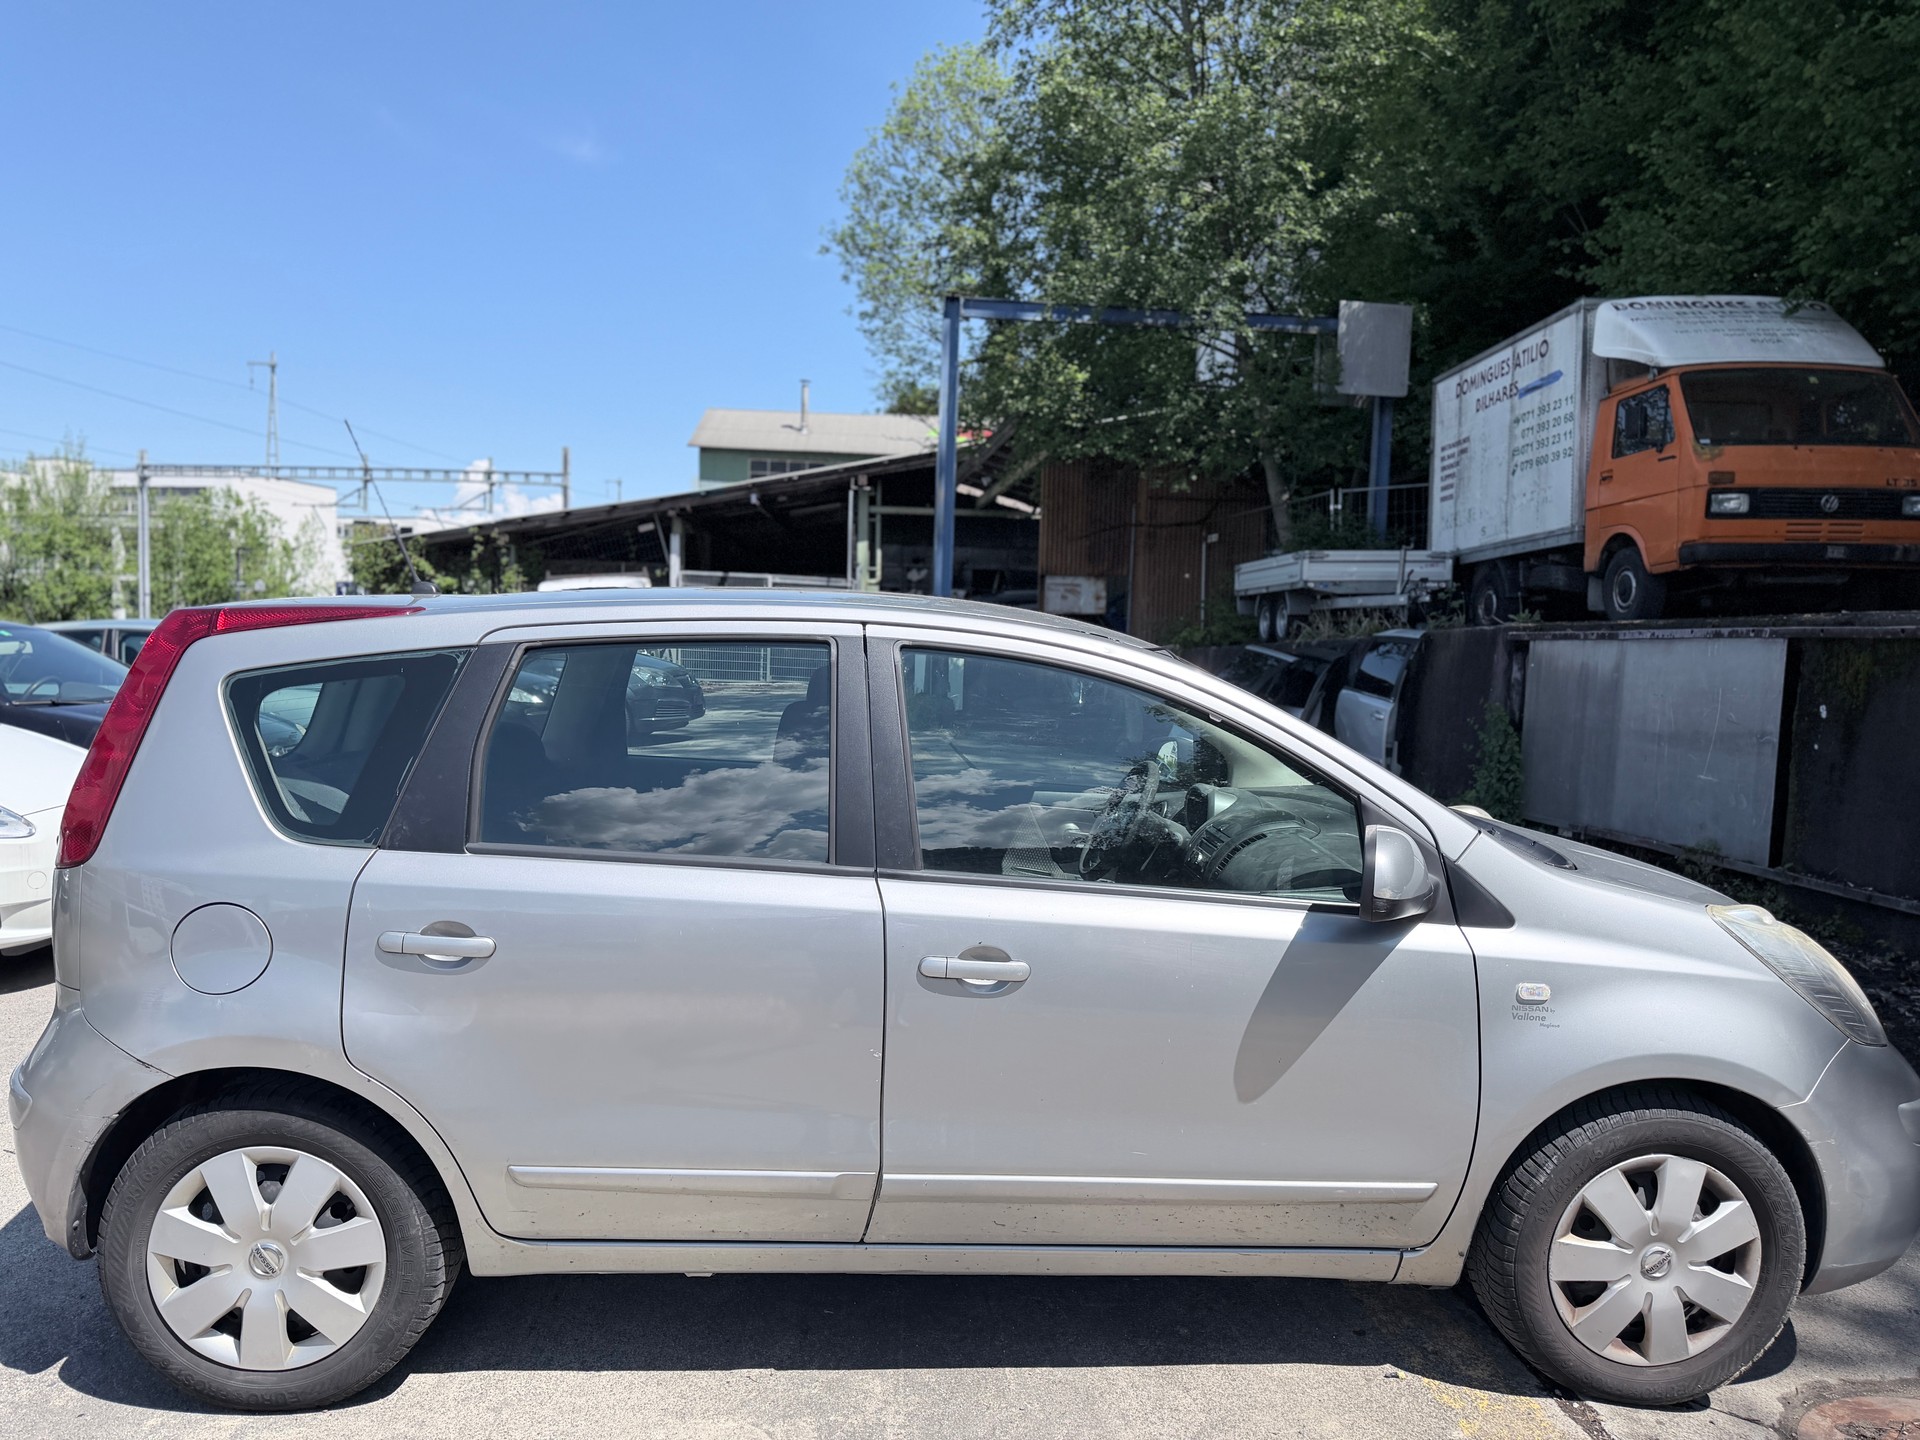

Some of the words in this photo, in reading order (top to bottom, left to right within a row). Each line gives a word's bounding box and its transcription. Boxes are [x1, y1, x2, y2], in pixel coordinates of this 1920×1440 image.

[1456, 357, 1511, 399] DOMINGUES
[1514, 339, 1549, 371] ATILIO
[1537, 402, 1551, 417] 393
[1553, 398, 1563, 411] 23
[1565, 394, 1574, 406] 11
[1536, 436, 1550, 451] 393
[1552, 432, 1561, 445] 23
[1563, 429, 1573, 441] 11
[1886, 478, 1900, 487] LT
[1511, 1005, 1549, 1013] NISSAN
[1511, 1012, 1547, 1022] Vallone
[254, 1247, 277, 1274] NISSAN
[1645, 1253, 1671, 1274] NISSAN
